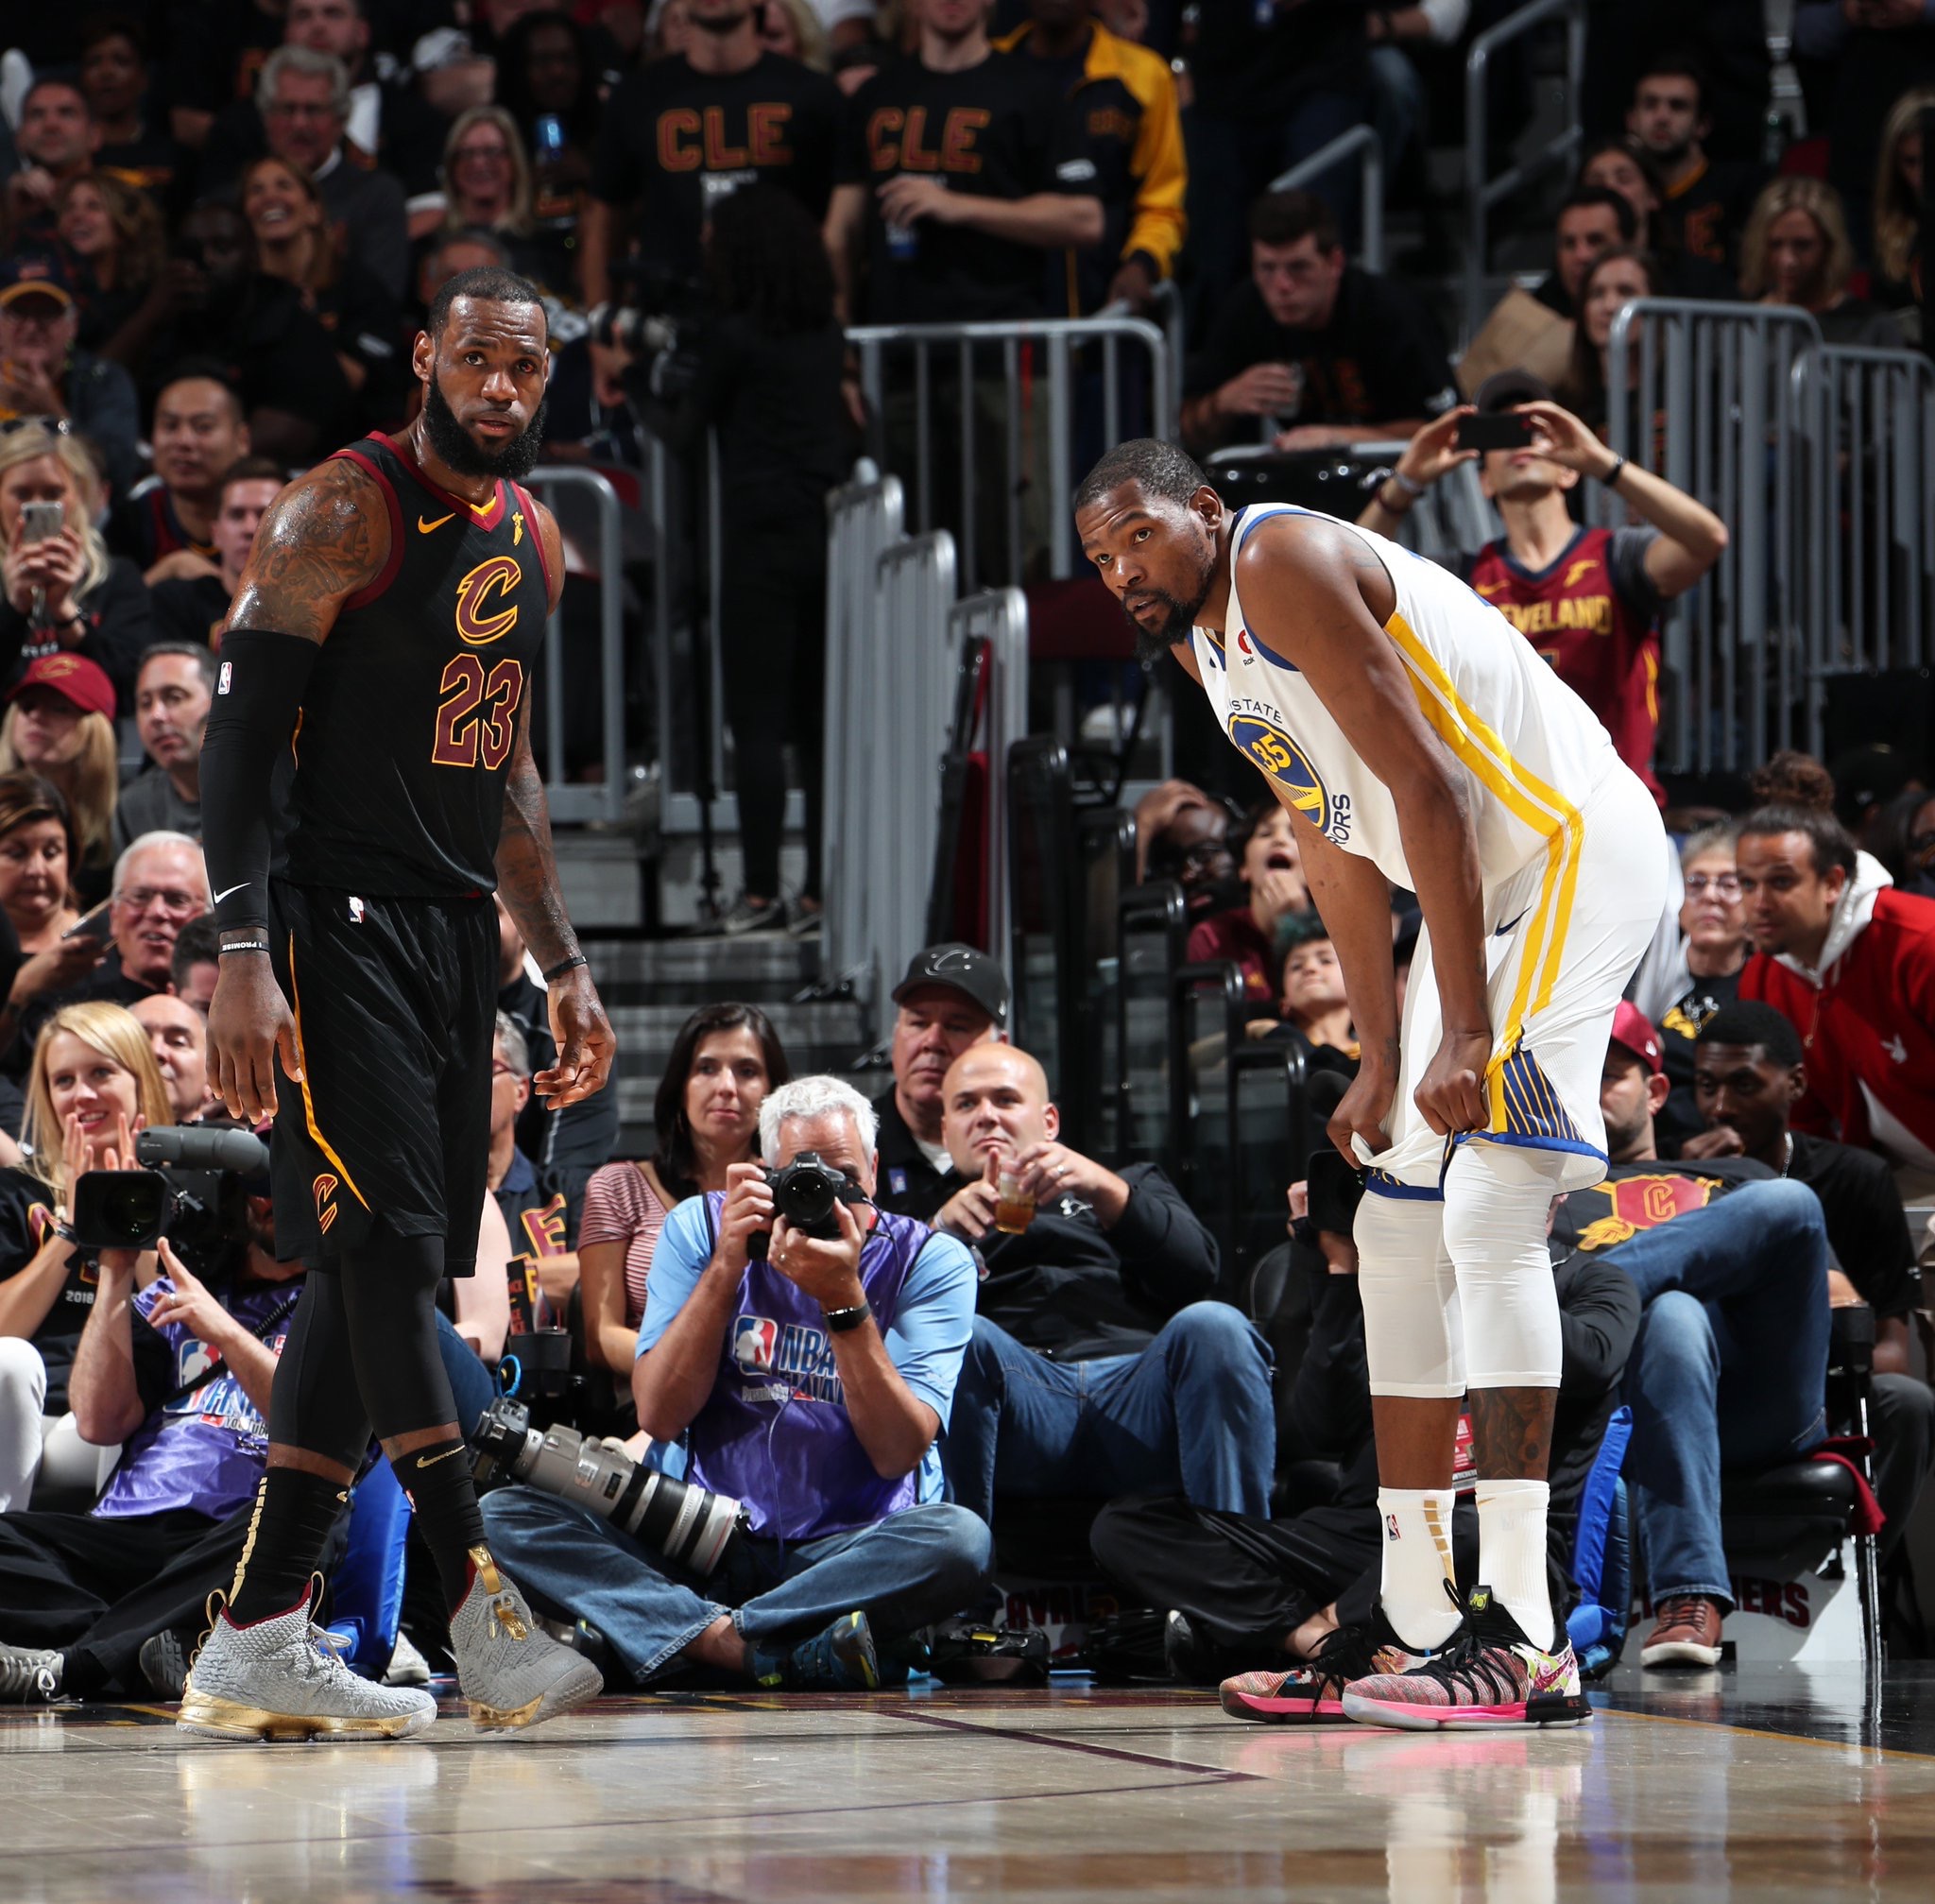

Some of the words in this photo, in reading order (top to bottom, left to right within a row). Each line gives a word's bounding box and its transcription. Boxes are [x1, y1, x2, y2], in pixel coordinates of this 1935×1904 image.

[658, 102, 793, 172] CLE
[865, 105, 990, 174] CLE
[432, 653, 522, 770] 23
[1231, 698, 1283, 724] STATE
[1252, 732, 1292, 773] 35
[222, 942, 257, 951] PROMISE
[1643, 1181, 1676, 1222] C
[65, 1290, 94, 1304] 2018
[778, 1323, 839, 1379] NBA
